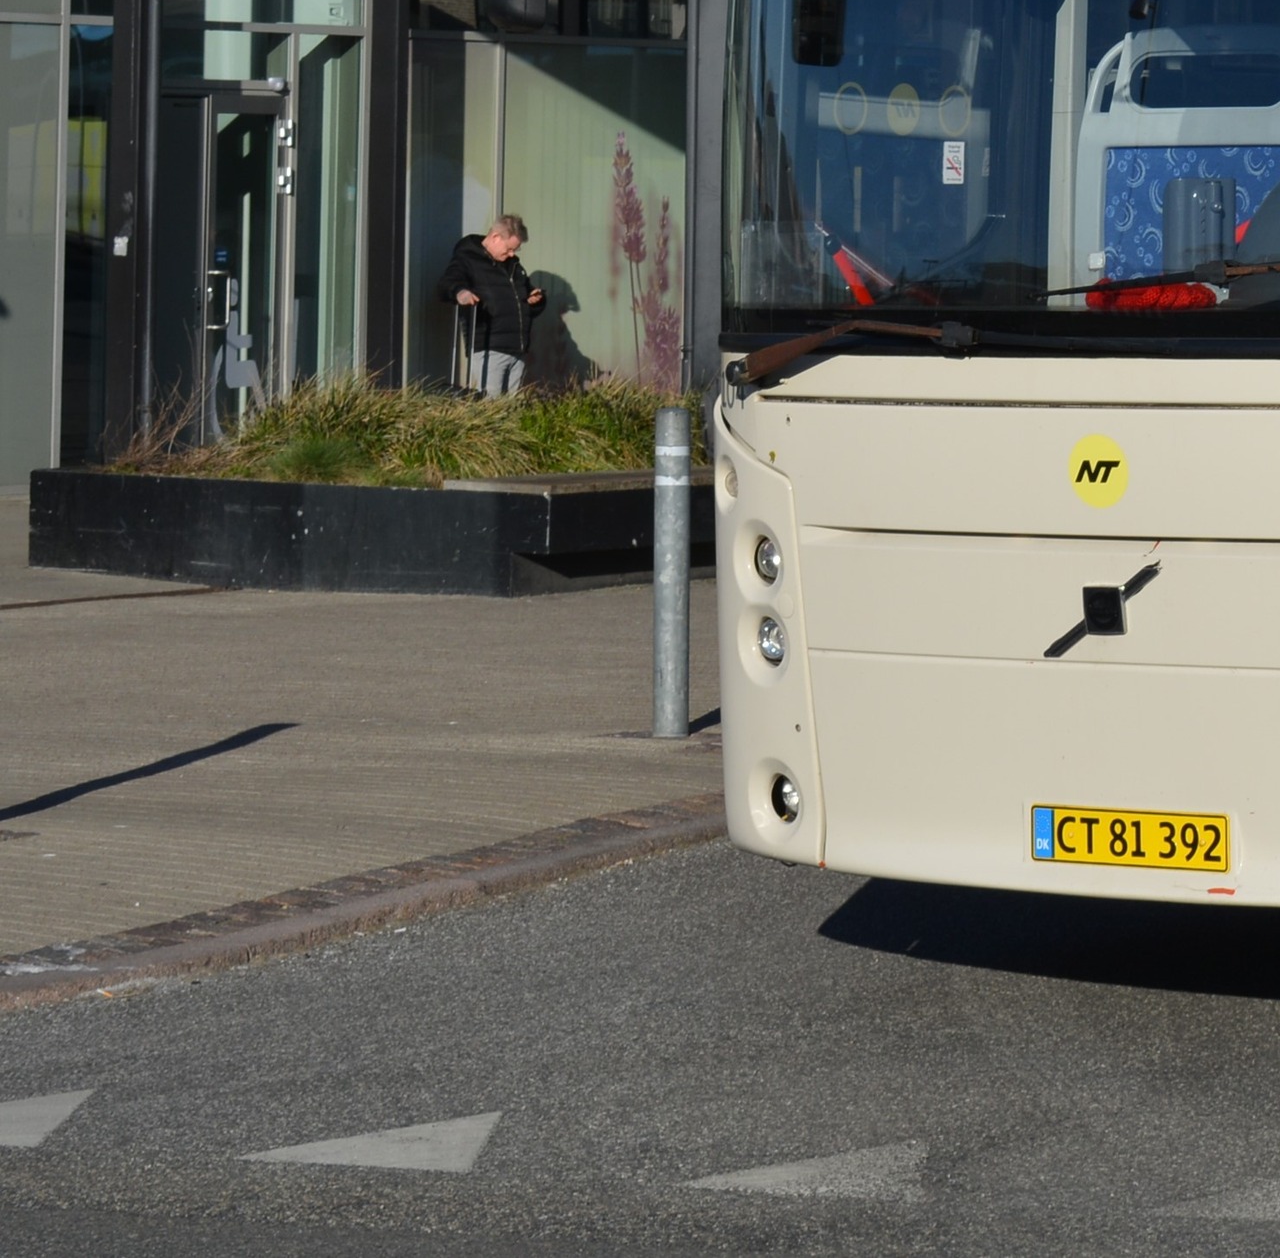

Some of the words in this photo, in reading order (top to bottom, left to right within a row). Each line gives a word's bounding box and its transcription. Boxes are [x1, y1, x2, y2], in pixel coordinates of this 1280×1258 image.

[1075, 460, 1121, 483] NT
[1036, 838, 1049, 850] DK
[1056, 816, 1100, 855] CT
[1109, 818, 1146, 858] 81
[1158, 821, 1222, 862] 392
